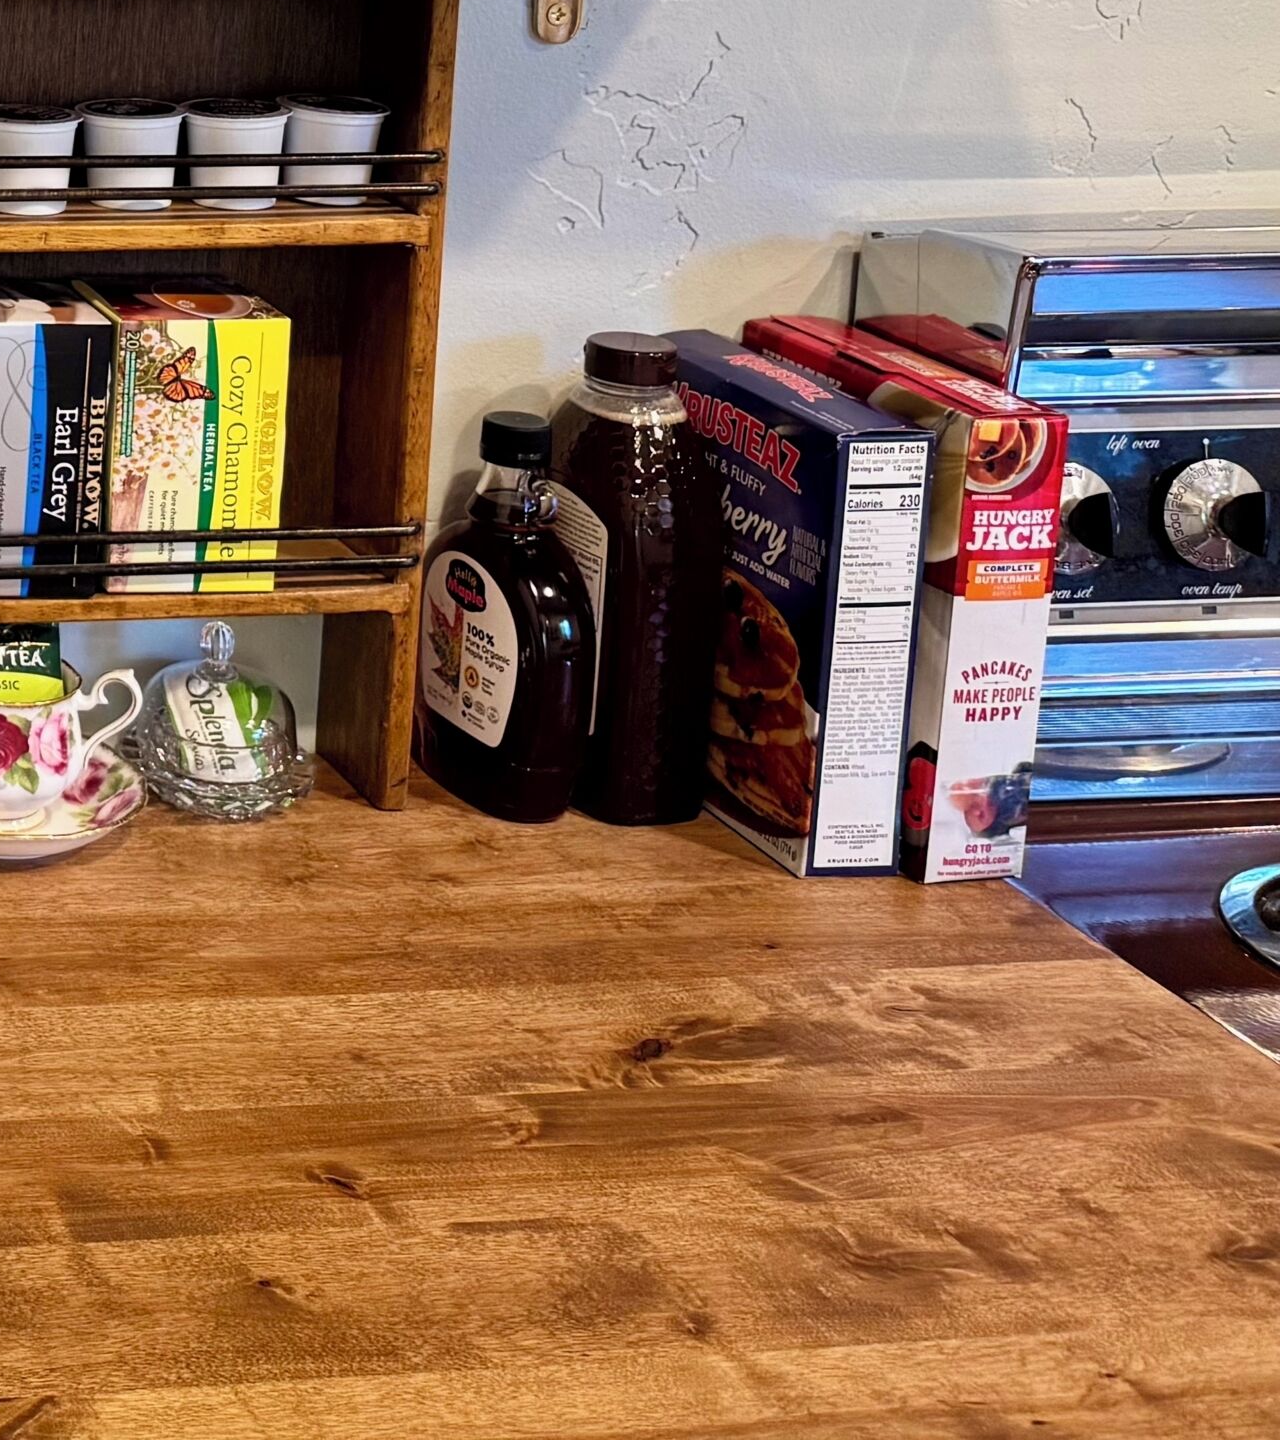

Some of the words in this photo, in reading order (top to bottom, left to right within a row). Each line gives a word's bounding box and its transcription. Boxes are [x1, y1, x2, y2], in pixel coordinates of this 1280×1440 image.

[222, 356, 252, 416] Cozy
[54, 407, 79, 456] Earl
[32, 433, 43, 469] BLACK
[204, 423, 216, 468] HERBAL
[256, 391, 279, 521] BIGELOW
[852, 444, 896, 455] Nutrition
[898, 444, 926, 455] Facts
[1106, 435, 1128, 456] left
[1132, 439, 1160, 450] oven
[83, 396, 106, 527] BIGELOW
[30, 473, 40, 494] TEA
[202, 471, 213, 492] TEA
[219, 422, 248, 558] Chamomle
[730, 464, 767, 497] FLUFFY
[42, 462, 76, 522] Grey
[847, 498, 883, 509] Calories
[899, 494, 921, 508] 230
[973, 509, 1055, 525] HUNGRY
[1171, 513, 1185, 538] 300
[966, 524, 1054, 551] JACK
[731, 552, 748, 568] JUST
[749, 560, 765, 575] ADD
[765, 570, 790, 590] WATER
[983, 564, 1035, 572] COMPLETE
[974, 574, 1041, 585] BUTTERMILK
[1182, 584, 1209, 595] oven
[1211, 582, 1243, 599] temp
[448, 579, 484, 608] Maple
[1074, 586, 1094, 598] set
[466, 622, 495, 648] 100%
[5, 649, 47, 667] TEA
[481, 644, 510, 666] Organic
[961, 660, 1033, 685] PANCAKES
[953, 689, 988, 704] MAKE
[991, 686, 1036, 703] PEOPLE
[965, 706, 1023, 722] HAPPY
[965, 844, 978, 854] GO
[980, 844, 992, 853] TO
[942, 856, 1010, 868] hungryjack.com
